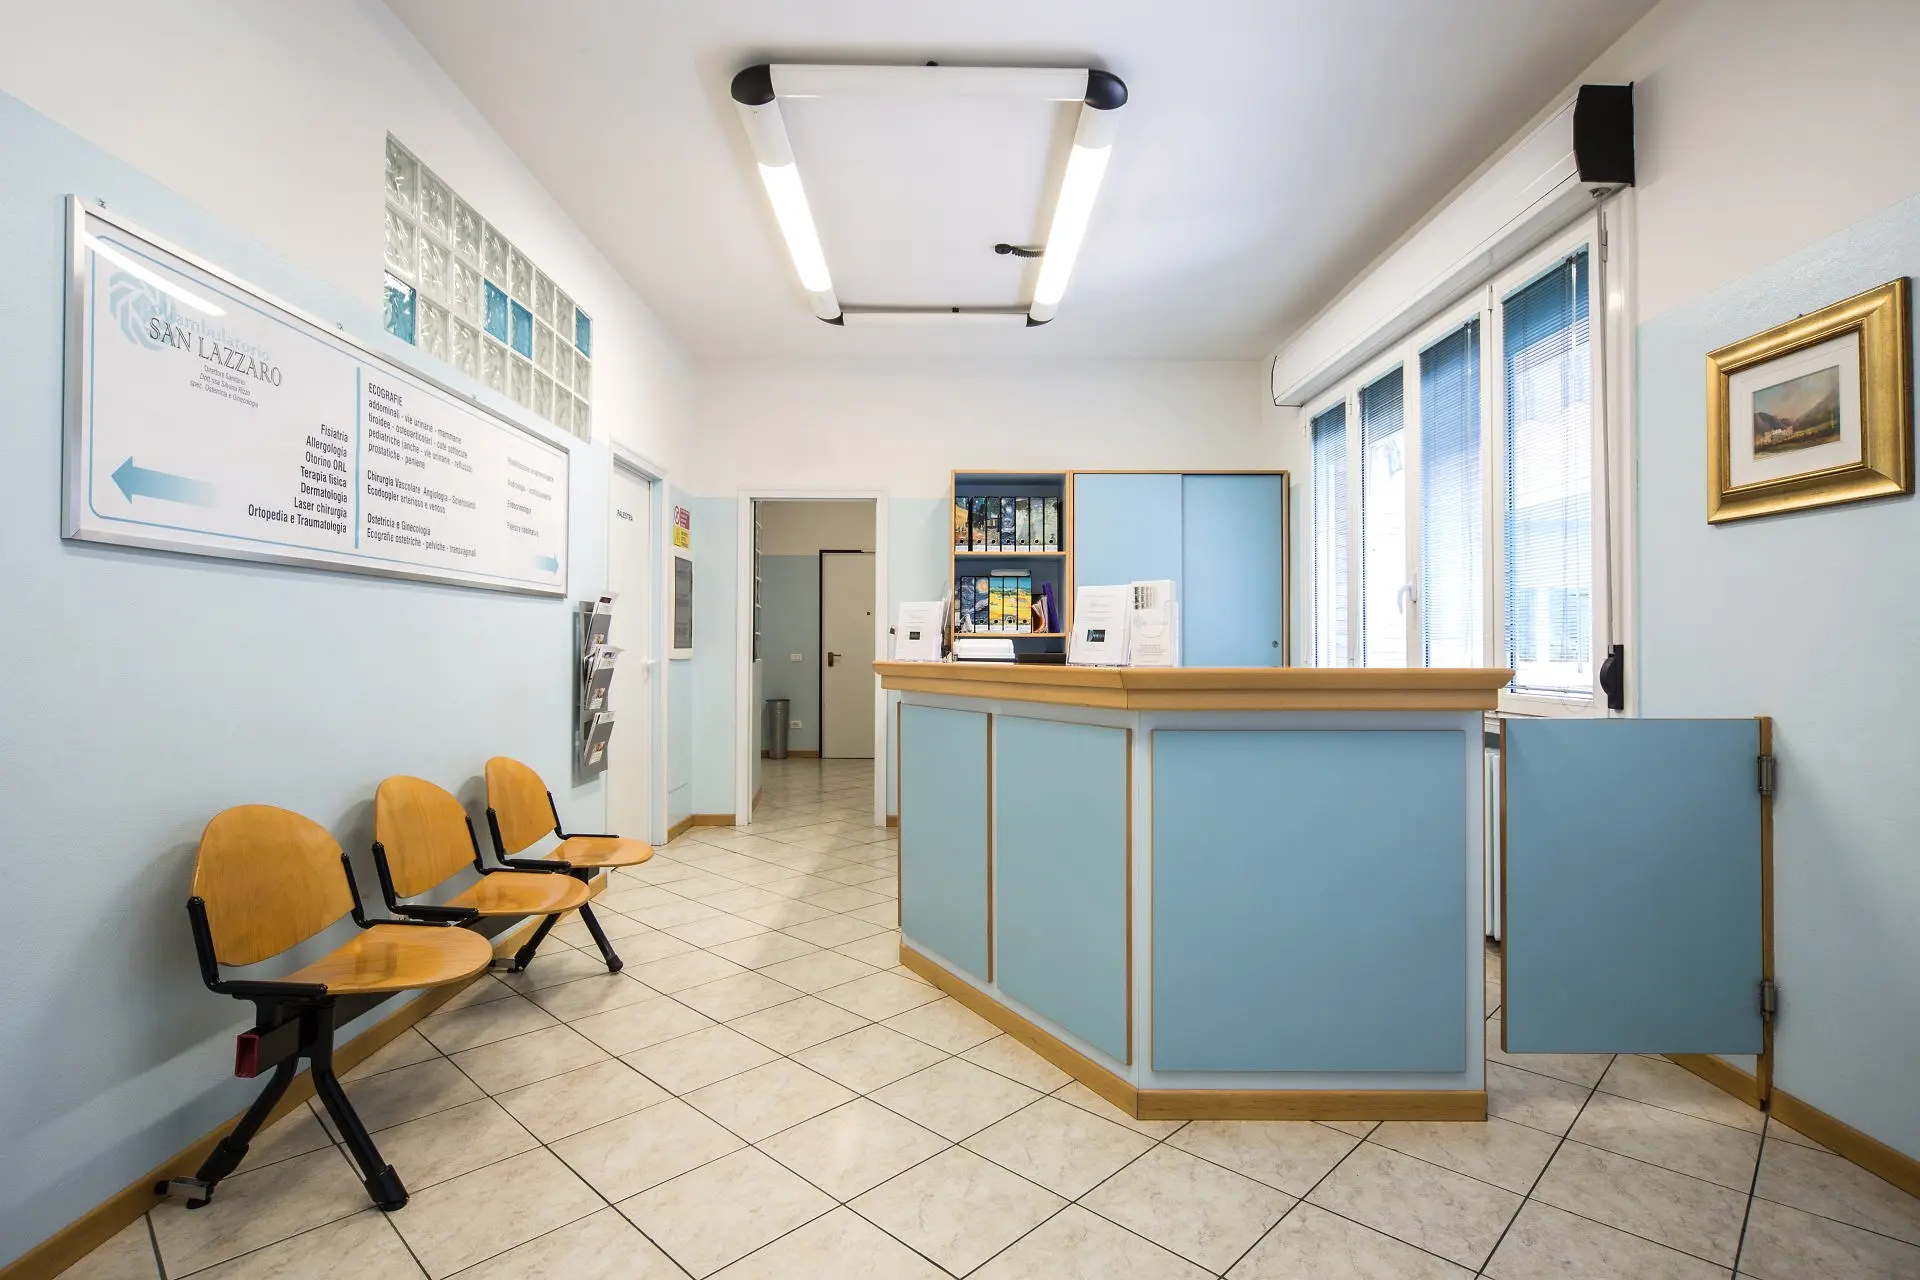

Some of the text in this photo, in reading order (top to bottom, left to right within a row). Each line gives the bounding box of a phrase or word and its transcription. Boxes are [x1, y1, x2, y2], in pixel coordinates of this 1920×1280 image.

[149, 316, 282, 387] SAN LAZZARO
[369, 383, 402, 406] ECOGRAFIE
[369, 399, 400, 419] addominali
[369, 413, 391, 429] tiroidee
[321, 424, 348, 442] Fisiatria
[369, 427, 400, 448] pediatriche
[306, 435, 347, 459] Allergologia
[368, 442, 400, 462] prostatiche
[306, 452, 347, 472] Otorino ORL
[301, 466, 347, 487] Terapia fisica
[368, 470, 394, 487] Chirurgia
[395, 478, 420, 493] Vascolare
[301, 482, 347, 504] Dermatologia
[368, 485, 399, 502] Ecodoppler
[401, 495, 423, 507] arterioso
[248, 504, 288, 524] Ortopedia
[297, 515, 347, 534] Traumatologia
[295, 497, 347, 519] Laser chirurgia
[368, 513, 394, 527] Ostetricia
[402, 521, 430, 537] Ginecologia
[367, 528, 394, 543] Ecografie
[396, 534, 421, 546] ostetriche
